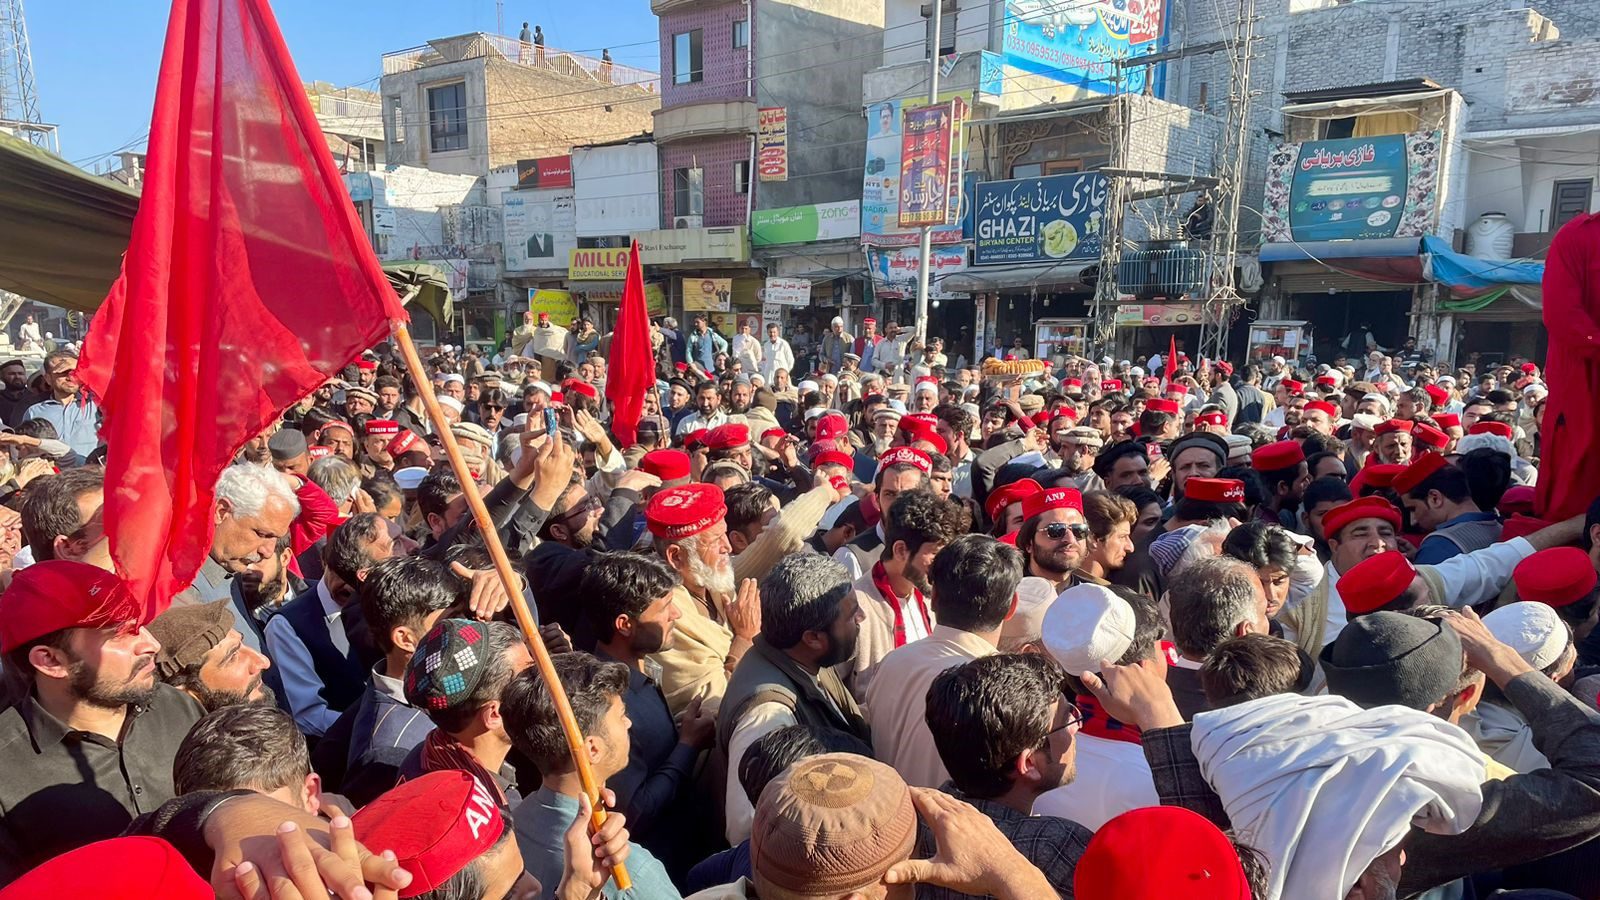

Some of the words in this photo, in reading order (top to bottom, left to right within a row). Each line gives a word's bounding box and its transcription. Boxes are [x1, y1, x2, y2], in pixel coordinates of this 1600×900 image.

[1301, 147, 1345, 171] بریانی
[1344, 143, 1375, 167] غازی
[902, 178, 943, 210] چارسدہ
[1030, 181, 1058, 212] بریانی
[1059, 175, 1107, 217] غازی
[863, 205, 888, 214] NADRA
[979, 216, 1036, 239] GHAZI
[980, 239, 1005, 247] BIRYANI
[1006, 237, 1035, 246] CENTER
[574, 251, 628, 268] MILLA
[573, 269, 610, 278] EDUCATIONAL
[611, 270, 627, 278] SERV
[1044, 491, 1066, 503] ANP
